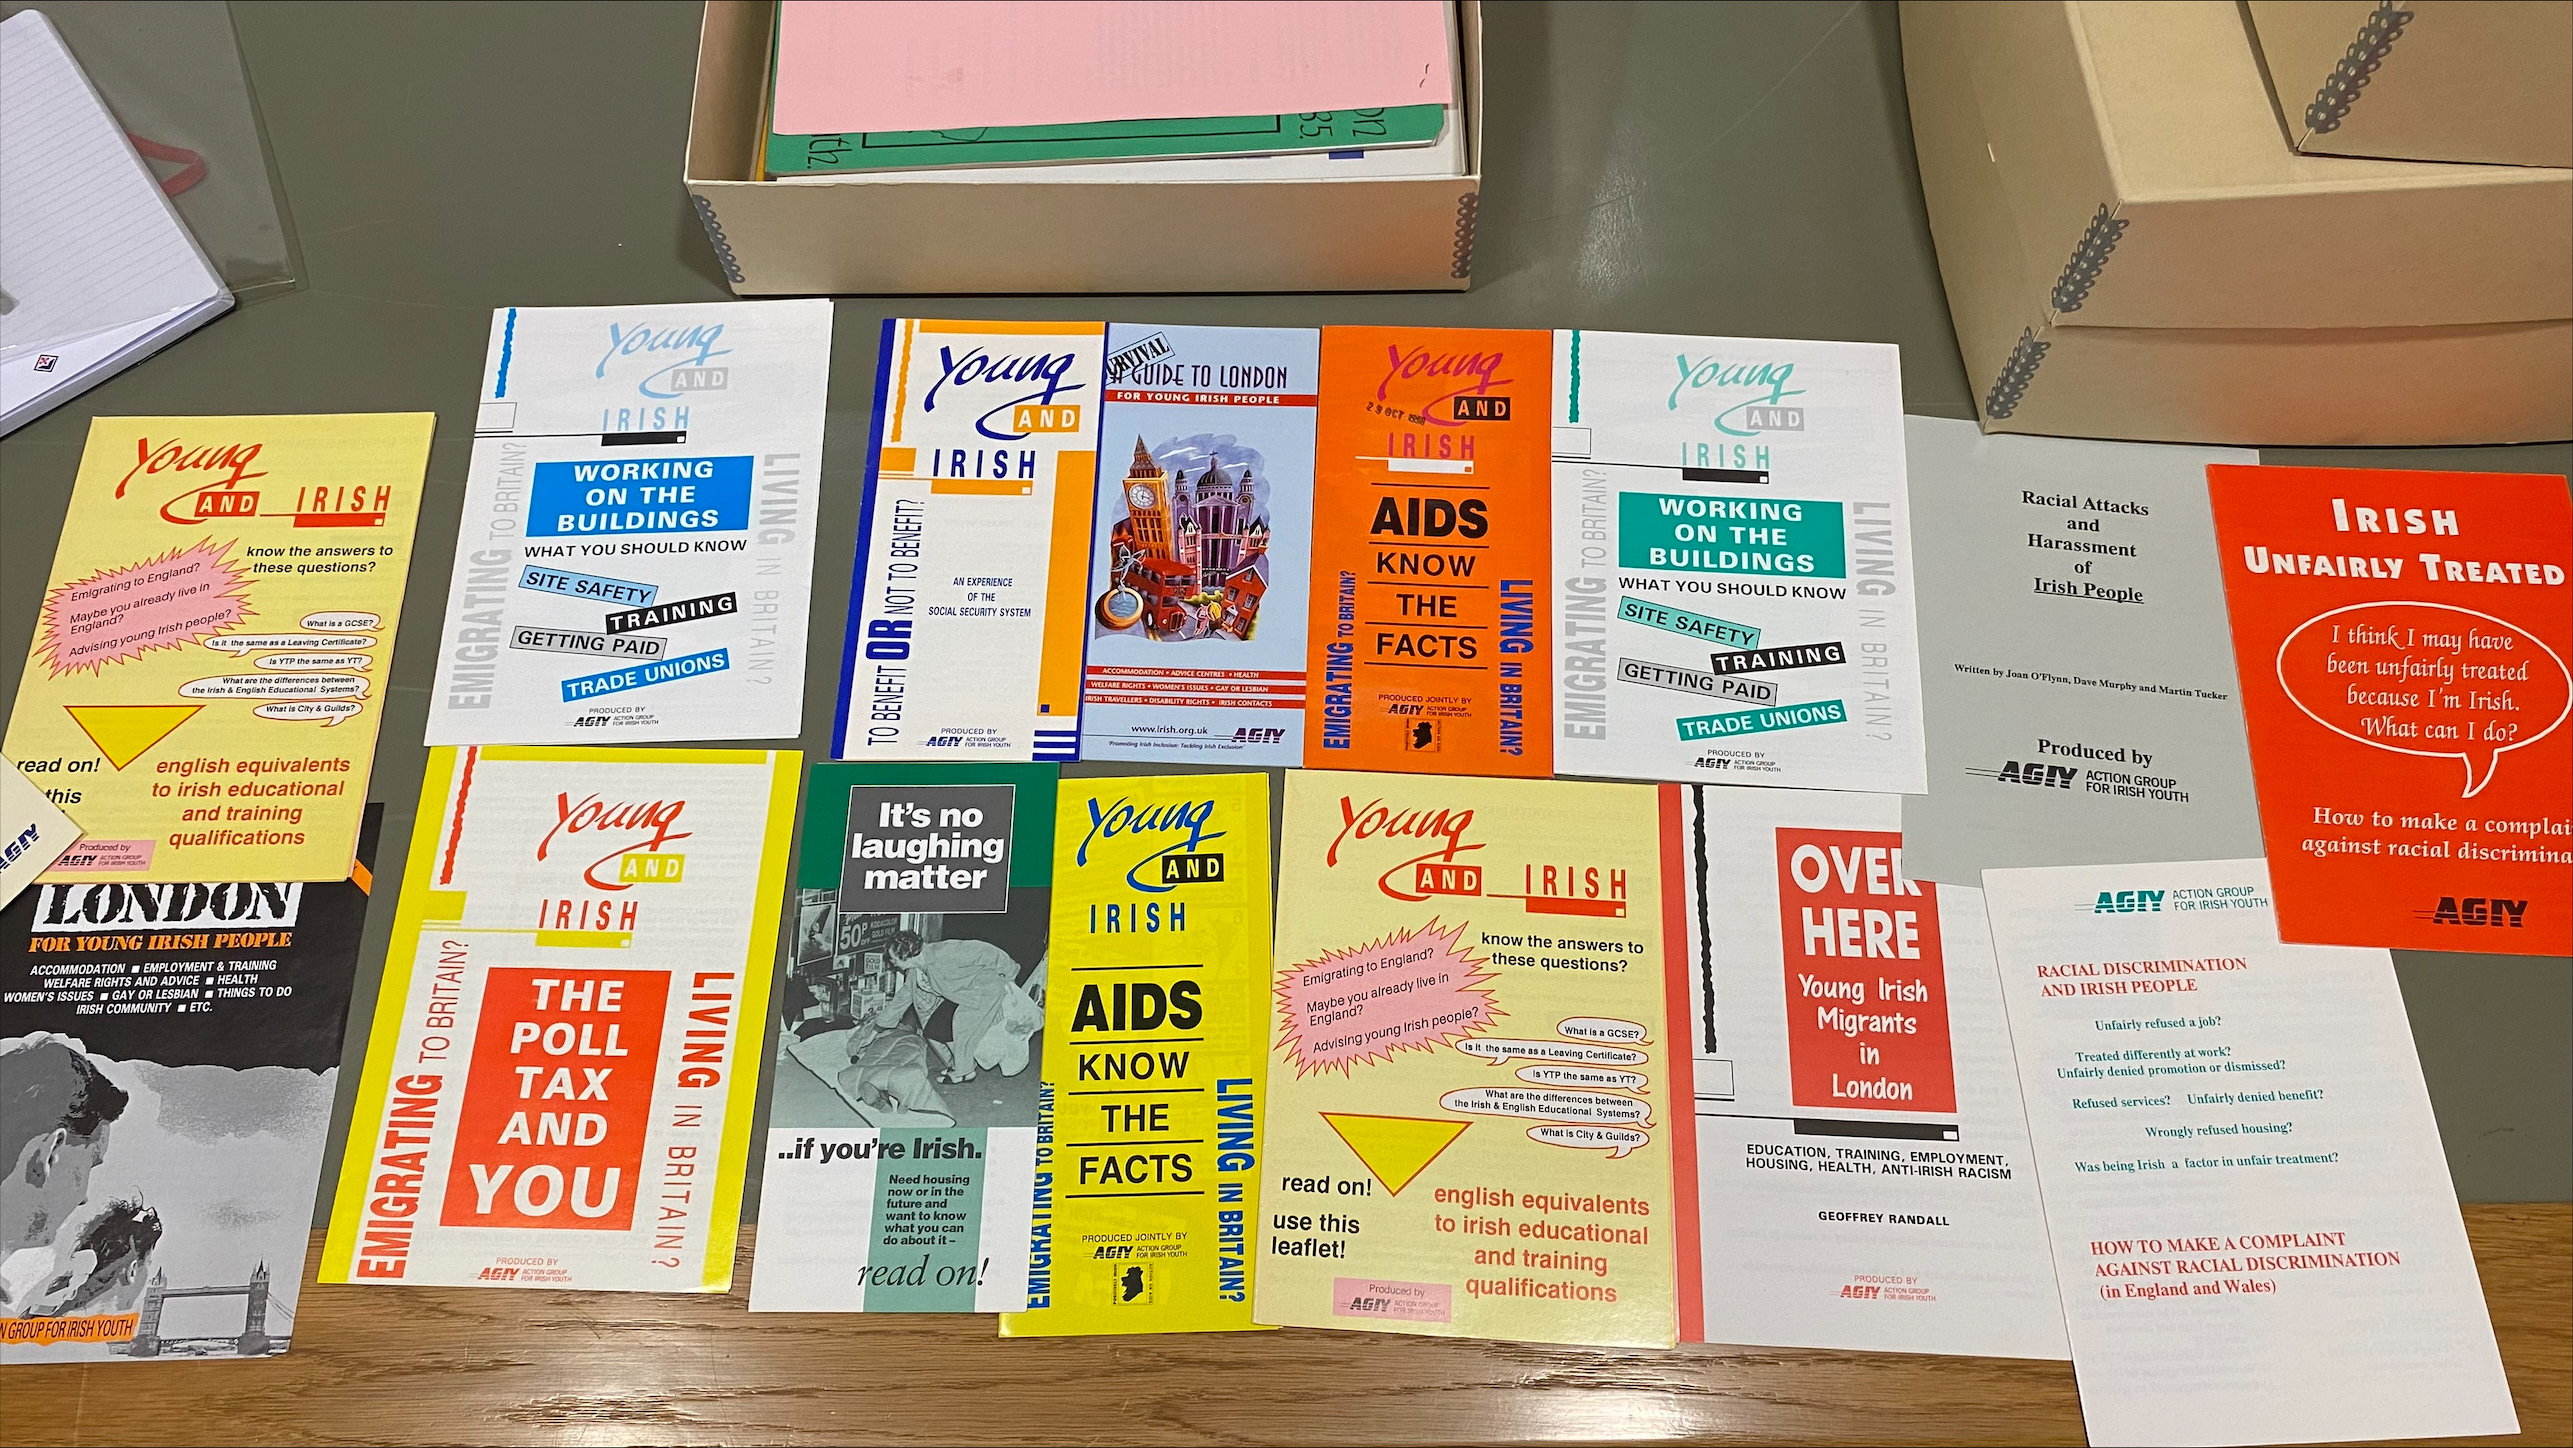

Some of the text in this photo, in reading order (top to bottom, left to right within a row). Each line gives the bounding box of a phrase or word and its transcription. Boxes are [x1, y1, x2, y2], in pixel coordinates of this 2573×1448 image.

[595, 323, 733, 378] Young
[676, 371, 724, 388] AND
[924, 346, 1086, 412] Young
[1132, 365, 1287, 388] GUIDE TO LONDON
[1118, 392, 1279, 404] FOR YOUNG IRISH PEOPLE
[603, 406, 689, 431] IRISH
[1018, 410, 1075, 428] AND
[115, 437, 268, 501] Young
[574, 461, 714, 482] WORKING
[933, 449, 1036, 479] IRISH
[200, 486, 391, 513] AND IRISH
[586, 486, 694, 507] ON THE
[757, 454, 800, 546] LIVING
[2022, 490, 2149, 517] Racial Attacks
[557, 510, 718, 532] BUILDINGS
[1370, 498, 1488, 539] AIDS
[1659, 499, 1802, 521] WORKING
[1674, 524, 1787, 546] ON THE
[2067, 516, 2100, 532] and
[247, 545, 393, 557] know the answers to
[2028, 533, 2137, 558] Harassment
[253, 561, 375, 575] these questions?
[1377, 553, 1475, 576] KNOW
[1650, 548, 1815, 572] BUILDINGS
[2074, 559, 2091, 575] of
[526, 572, 651, 603] SITE SAFETY
[953, 577, 1013, 587] AN EXPERIENCE
[1619, 578, 1846, 599] WHAT YOU SHOULD KNOW
[2034, 578, 2143, 604] Irish People
[968, 593, 995, 601] OF THE
[1397, 594, 1457, 617] THE
[610, 596, 732, 631] TRAINING
[929, 607, 1031, 617] SOCIAL SECURITY SYSTEM
[448, 550, 512, 710] EMIGRATING
[866, 619, 913, 660] OR
[518, 630, 659, 656] GETTING PAID
[1378, 633, 1477, 659] FACTS
[567, 653, 725, 697] TRADE UNIONS
[1132, 725, 1208, 734] www.irish.org.uk
[1232, 728, 1285, 743] AGIY
[2361, 717, 2517, 743] What can I do?
[157, 758, 350, 774] english equivalents
[2038, 739, 2153, 768] Produced by
[1998, 761, 2078, 789] AGIY
[538, 792, 693, 861] Young
[879, 803, 984, 828] It's no
[1077, 798, 1227, 867] Young
[1327, 797, 1486, 867] Young
[851, 832, 1005, 864] laughing
[624, 859, 679, 878] AND
[864, 867, 987, 890] matter
[1167, 859, 1219, 880] AND
[1420, 865, 1626, 899] AND IRISH
[43, 883, 287, 925] LONDON
[538, 899, 638, 931] IRISH
[1090, 902, 1186, 933] IRISH
[29, 931, 291, 953] FOR YOUNG IRISH PEOPLE
[1801, 909, 1921, 959] HERE
[31, 963, 126, 974] ACCOMMODATION
[143, 961, 213, 973] EMPLOYMENT
[228, 959, 276, 971] TRAINING
[2037, 957, 2247, 978] RACIAL DISCRIMINATION
[531, 979, 624, 1012] THE
[1798, 973, 1928, 1003] Young Irish
[2041, 978, 2198, 997] AND IRISH PEOPLE
[1071, 981, 1202, 1032] AIDS
[1818, 1007, 1916, 1038] Migrants
[2095, 1019, 2142, 1031] Unfairly
[2145, 1018, 2186, 1030] refused
[2198, 1015, 2221, 1029] job?
[510, 1022, 629, 1056] POLL
[1079, 1051, 1189, 1080] KNOW
[1859, 1043, 1879, 1065] in
[515, 1067, 609, 1101] TAX
[1832, 1074, 1912, 1100] London
[498, 1112, 607, 1146] AND
[1101, 1104, 1169, 1132] THE
[1541, 1128, 1561, 1137] What
[1575, 1131, 1593, 1141] City
[1606, 1133, 1640, 1142] Guilds?
[820, 1139, 908, 1163] you're
[913, 1139, 983, 1160] Irish.
[1747, 1144, 2009, 1167] EDUCATION, TRAINING, EMPLOYMENT,
[1080, 1154, 1193, 1183] FACTS
[469, 1164, 621, 1216] YOU
[1282, 1175, 1372, 1196] read on!
[1273, 1214, 1360, 1234] use this
[1818, 1211, 1949, 1226] GEOFFREY RANDALL
[1271, 1237, 1345, 1259] leaflet!
[2091, 1232, 2345, 1256] HOW TO MAKE A COMPLAINT
[858, 1255, 987, 1287] read on!
[8, 1322, 45, 1339] GROUP
[45, 1321, 66, 1338] FOR
[67, 1320, 94, 1337] IRISH
[98, 1320, 133, 1336] YOUTH
